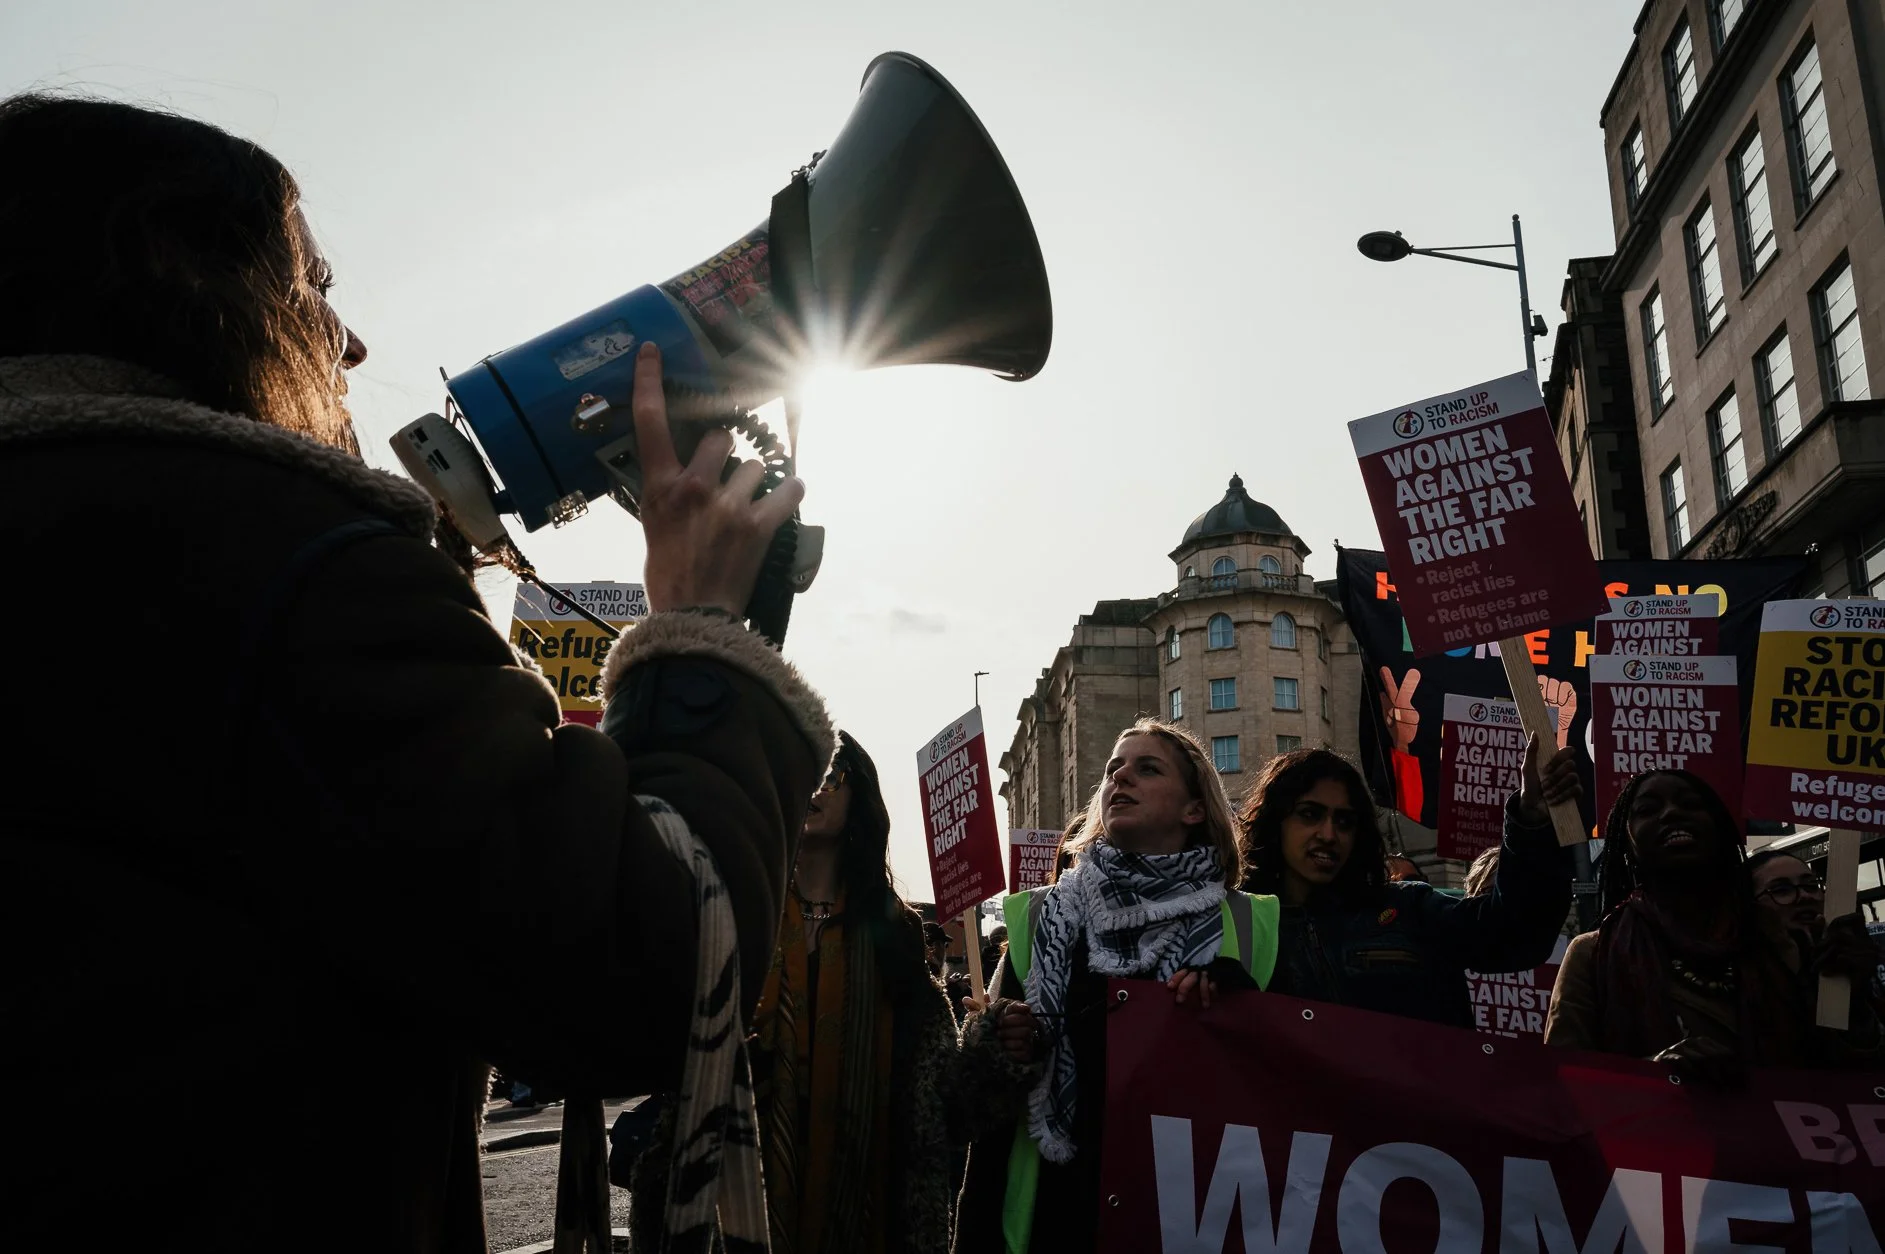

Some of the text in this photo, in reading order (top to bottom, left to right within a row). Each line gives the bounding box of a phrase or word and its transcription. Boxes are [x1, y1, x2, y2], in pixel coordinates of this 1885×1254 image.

[1425, 391, 1489, 418] STAND UP
[1428, 402, 1500, 431] TO RACISM
[1382, 424, 1509, 479] WOMEN
[1396, 447, 1534, 508] AGAINST
[1398, 480, 1536, 535] THE FAR
[1407, 517, 1506, 566] RIGHT
[1425, 561, 1481, 585] Reject
[580, 589, 644, 602] STAND UP
[1432, 575, 1516, 604] racist lies
[599, 603, 649, 616] RACISM
[1436, 587, 1549, 624] Refugees are
[1646, 607, 1691, 616] TO RACISM
[1675, 599, 1688, 607] UP
[1443, 624, 1473, 644] not
[1475, 619, 1493, 635] to
[1496, 608, 1551, 631] blame
[1611, 620, 1690, 639] WOMEN
[1845, 618, 1863, 629] TO
[519, 628, 612, 666] Refug
[1610, 638, 1703, 656] AGAINST
[1806, 636, 1885, 667] STO
[1649, 662, 1699, 671] STAND UP
[1649, 671, 1704, 681] TO RACISM
[1783, 667, 1885, 700] RACI
[1610, 686, 1704, 709] WOMEN
[1490, 705, 1516, 715] STAND
[1491, 715, 1501, 723] TO
[1611, 708, 1721, 732] AGAINST
[1770, 698, 1885, 734] REFO
[940, 723, 963, 746] STAND UP
[940, 732, 967, 755] TO RACISM
[1611, 730, 1713, 754] THE FAR
[1455, 744, 1525, 769] AGAINS
[1613, 752, 1688, 774] RIGHT
[1827, 734, 1885, 768] UK
[925, 747, 970, 794] WOMEN
[1454, 763, 1521, 788] THE FA
[929, 763, 979, 815] AGAINST
[1790, 772, 1885, 803] Refuge
[930, 789, 980, 835] THE FAR
[933, 818, 967, 858] RIGHT
[1488, 822, 1503, 833] lie
[1019, 846, 1057, 859] WOME
[1019, 858, 1055, 870] AGAIN
[958, 861, 969, 874] lies
[970, 871, 983, 887] are
[1018, 870, 1042, 882] THE
[961, 886, 983, 905] blame
[1496, 1007, 1544, 1034] FAR
